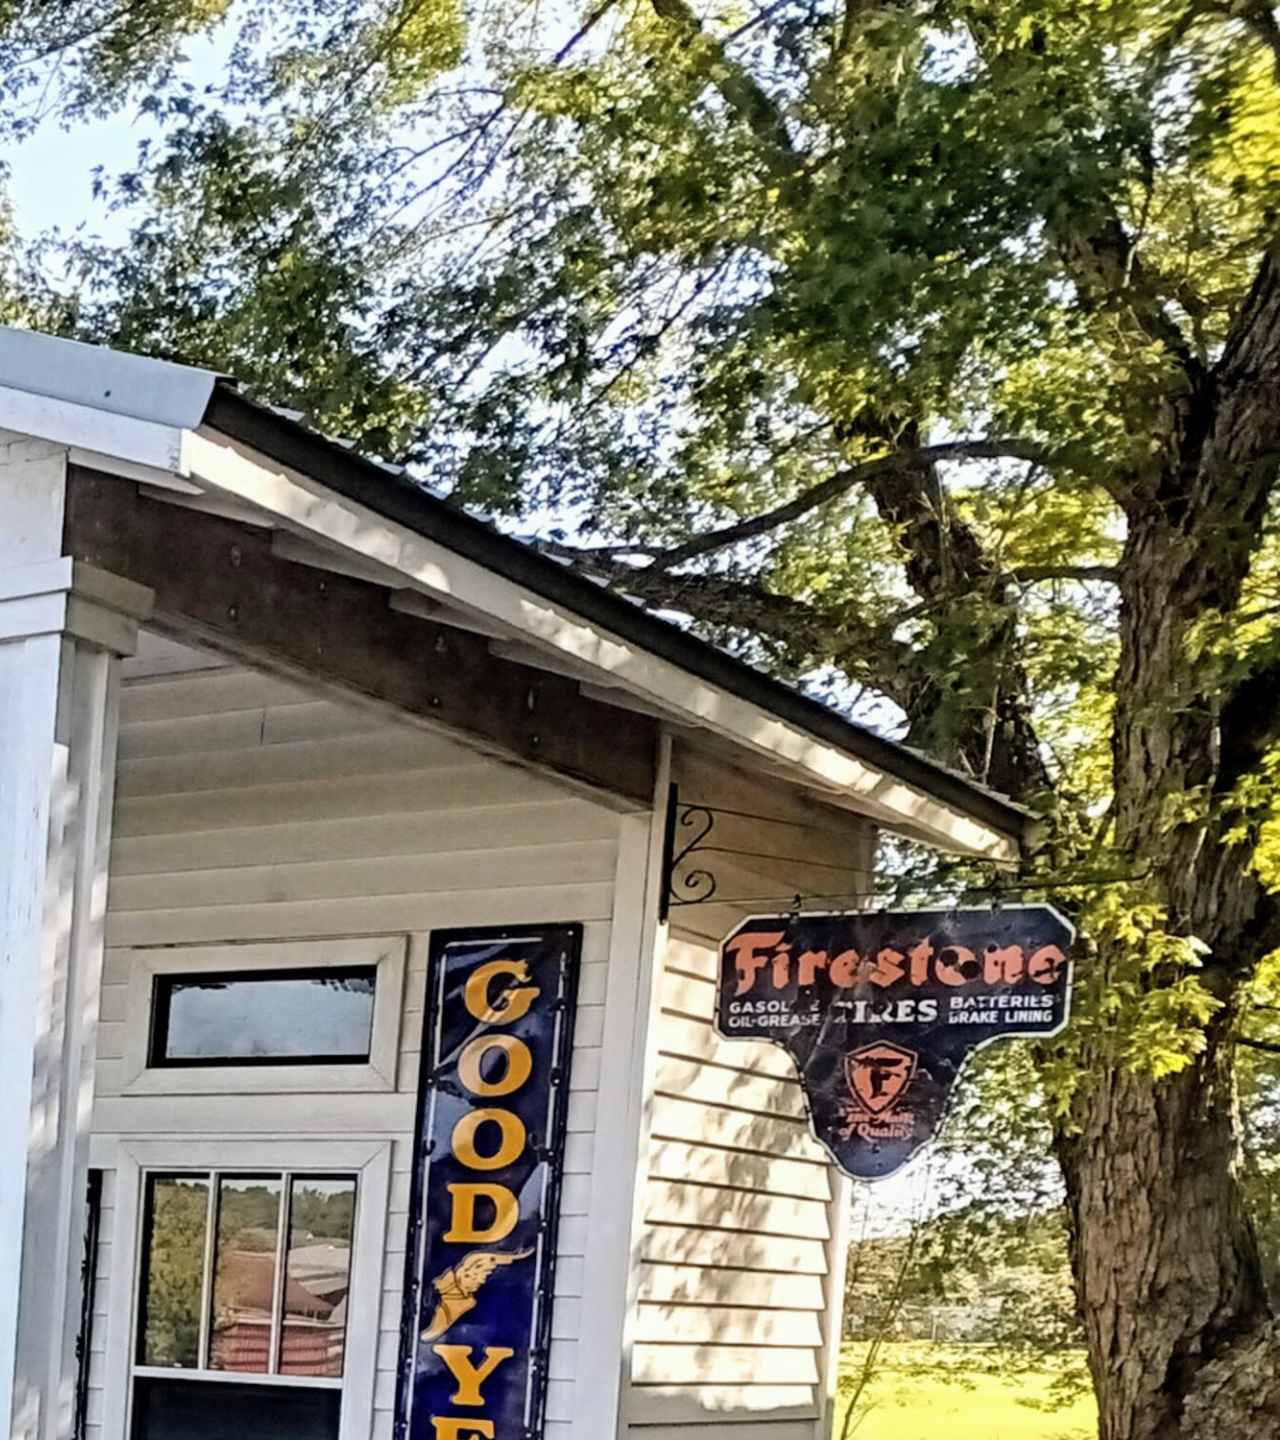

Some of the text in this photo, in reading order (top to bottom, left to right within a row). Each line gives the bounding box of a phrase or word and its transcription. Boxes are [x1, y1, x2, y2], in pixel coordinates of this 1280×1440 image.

[724, 930, 1071, 997] Firestone
[729, 1000, 820, 1014] GASOLE
[949, 994, 1054, 1010] BATTERIES
[948, 1009, 1053, 1024] BRAKE LINING
